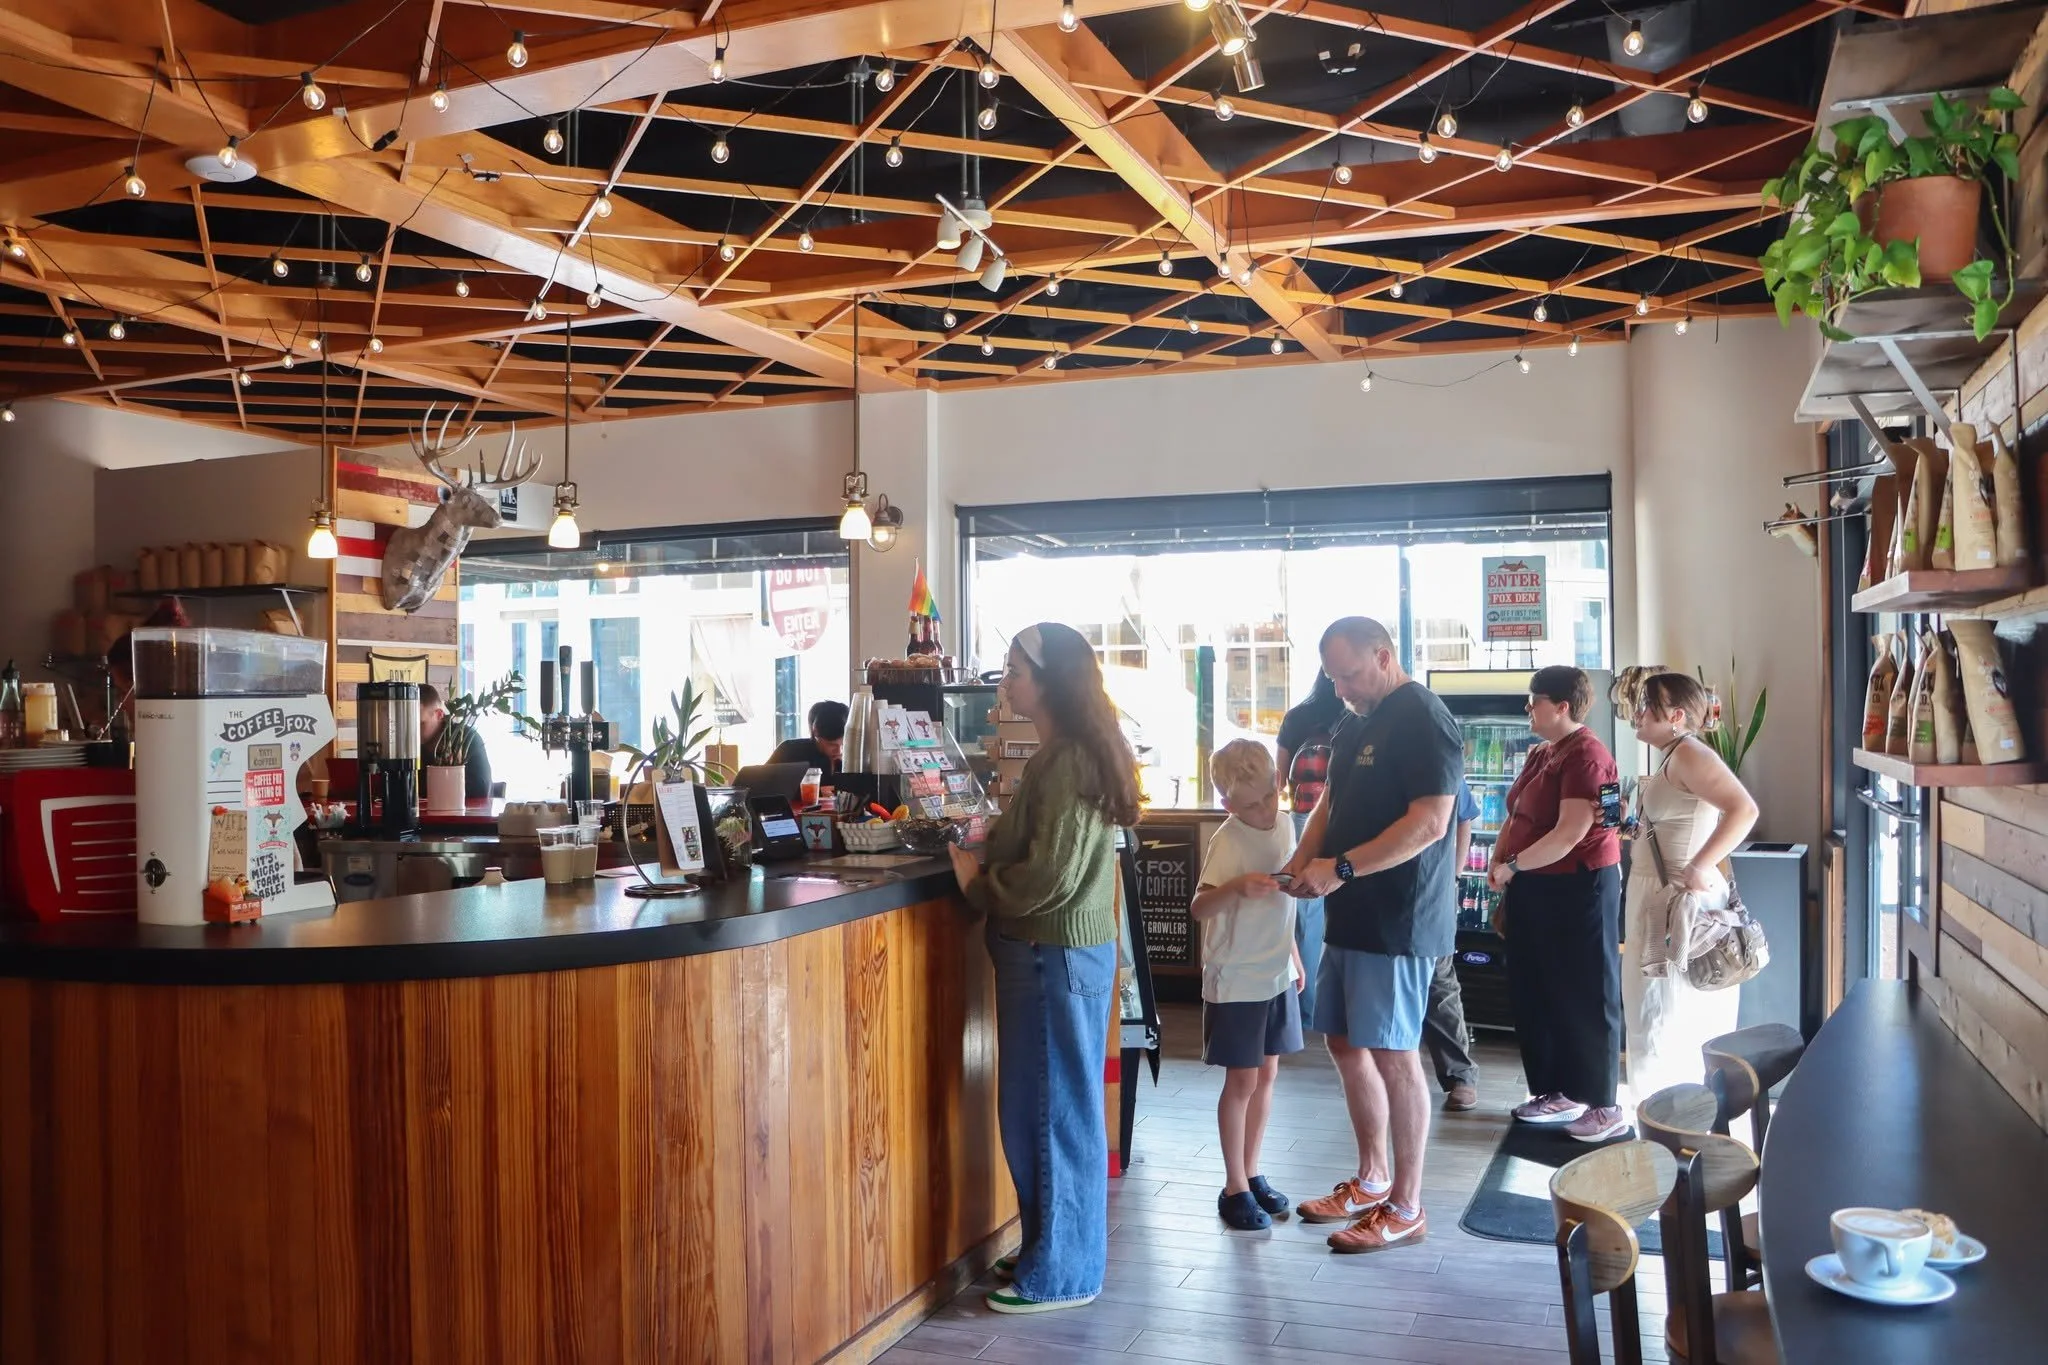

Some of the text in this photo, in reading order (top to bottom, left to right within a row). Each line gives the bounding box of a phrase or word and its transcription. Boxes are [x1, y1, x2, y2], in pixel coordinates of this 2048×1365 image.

[776, 569, 793, 585] DO
[1487, 574, 1541, 587] ENTER
[1492, 592, 1536, 603] FOX DEN
[1528, 609, 1542, 617] TIME
[783, 611, 821, 634] ENTER
[389, 669, 412, 682] DON'T
[229, 711, 243, 719] THE
[227, 710, 312, 740] COFFEE FOX
[254, 774, 272, 787] COFFEE
[272, 772, 283, 785] FOX
[251, 863, 285, 880] MICRO-
[1147, 861, 1185, 875] FOX
[256, 875, 285, 889] FOAM-
[1146, 876, 1187, 897] COFFEE
[258, 882, 286, 899] ABLE!
[1147, 921, 1187, 935] GROWLERS
[1146, 944, 1186, 955] your day!
